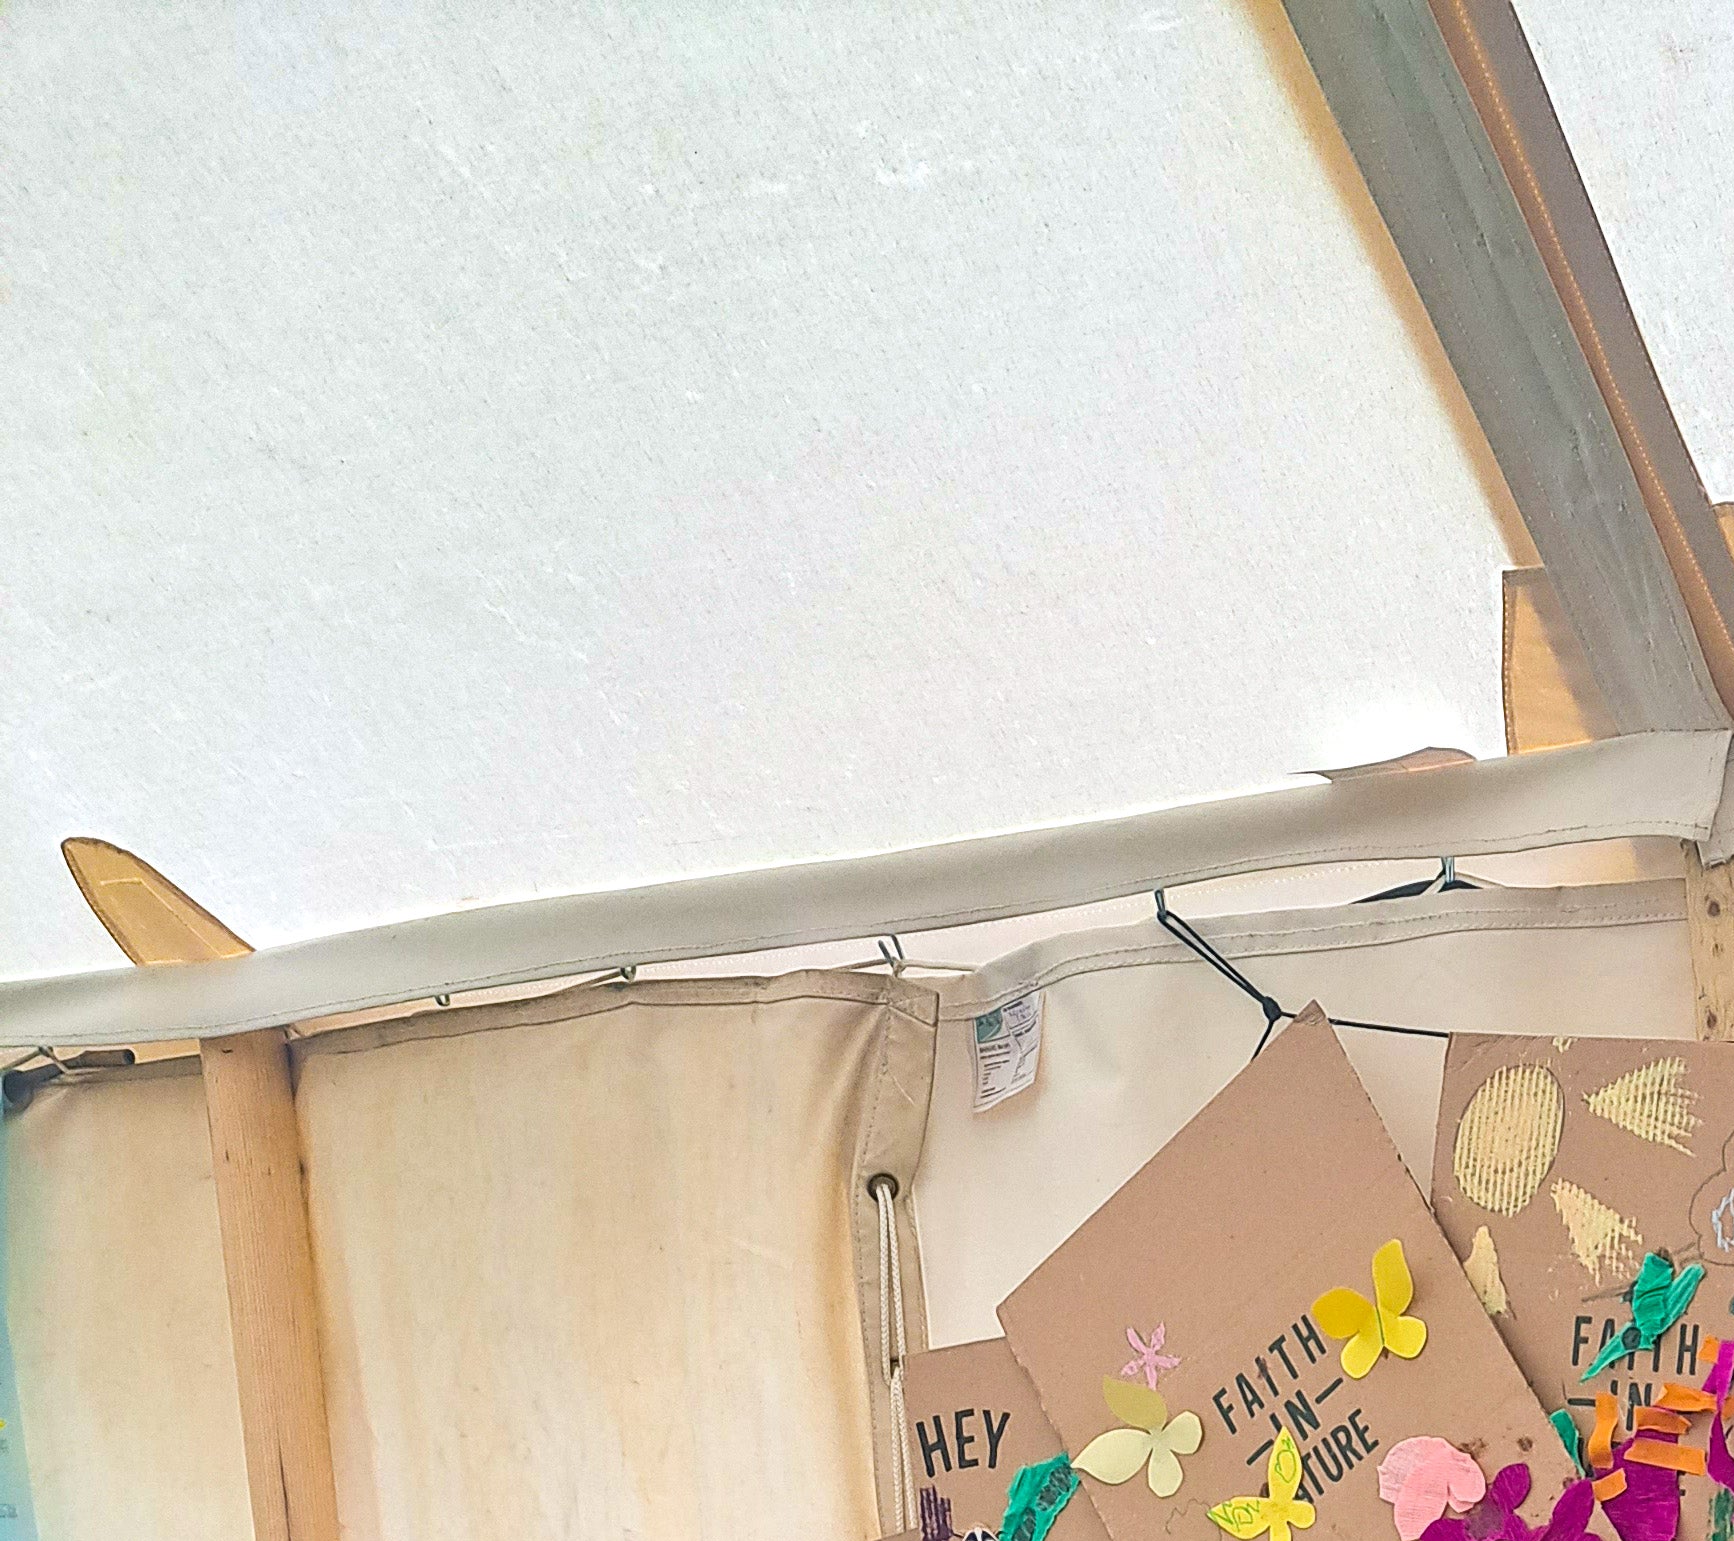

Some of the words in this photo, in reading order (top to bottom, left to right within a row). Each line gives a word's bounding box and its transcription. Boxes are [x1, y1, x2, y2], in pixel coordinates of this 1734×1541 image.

[1212, 1314, 1327, 1435] FAITH
[916, 1407, 1011, 1478] HEY
[1295, 1408, 1380, 1505] TURE
